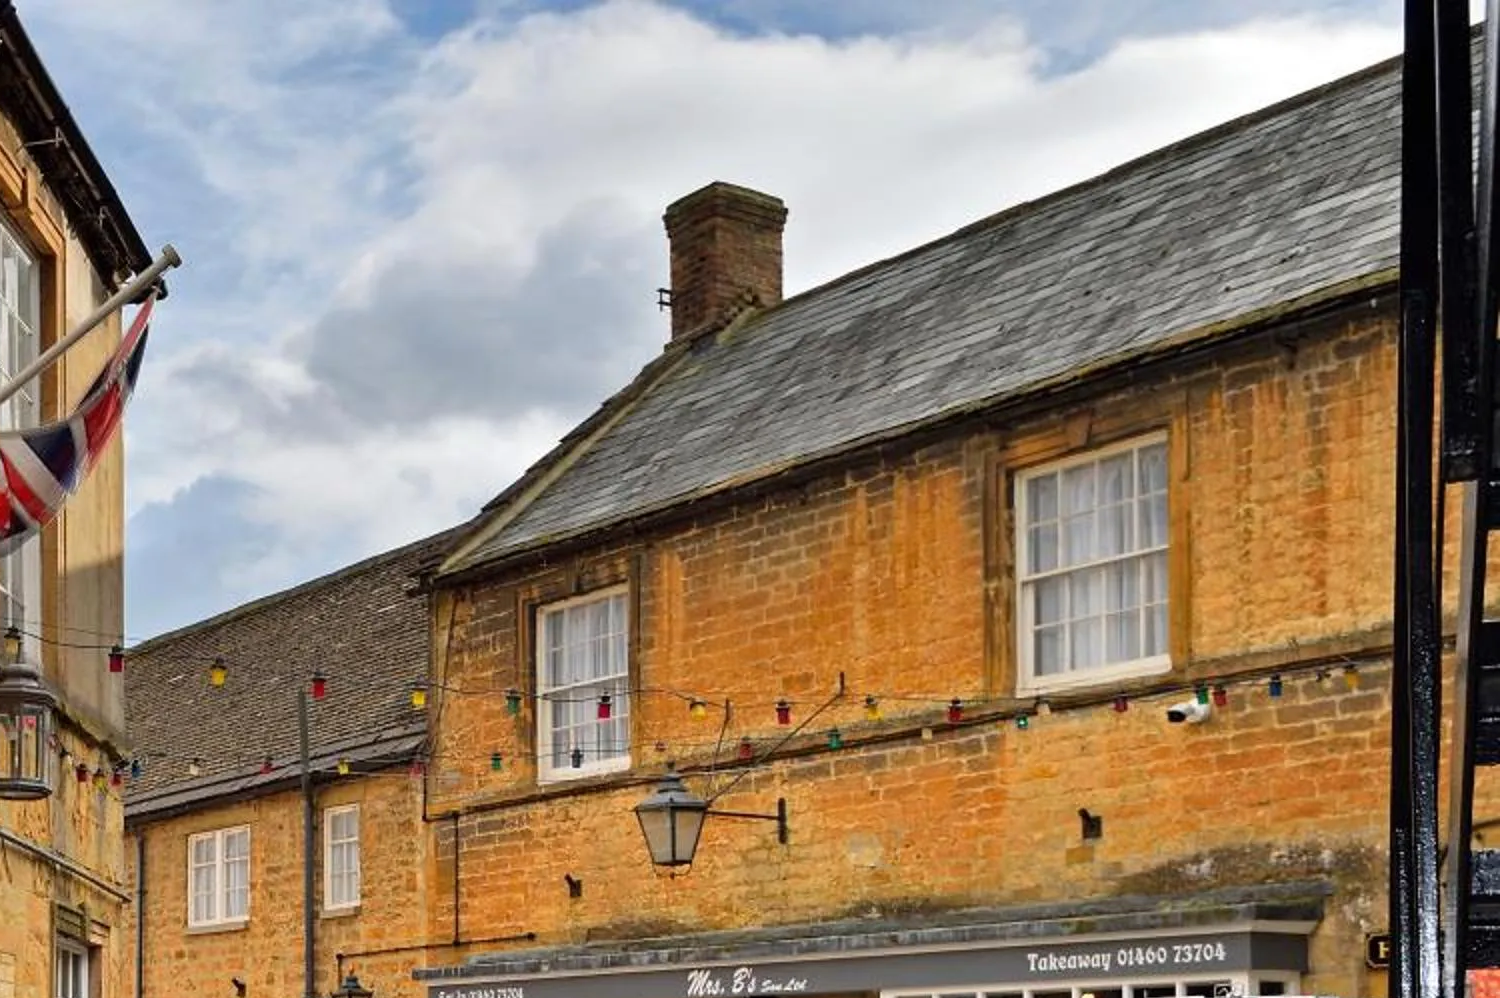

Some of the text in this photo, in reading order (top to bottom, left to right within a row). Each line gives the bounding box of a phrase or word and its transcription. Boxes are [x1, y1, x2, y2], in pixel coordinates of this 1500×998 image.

[1028, 942, 1227, 972] Takeaway 01460 73704
[687, 969, 725, 998] Mrs.
[732, 967, 757, 994] B's
